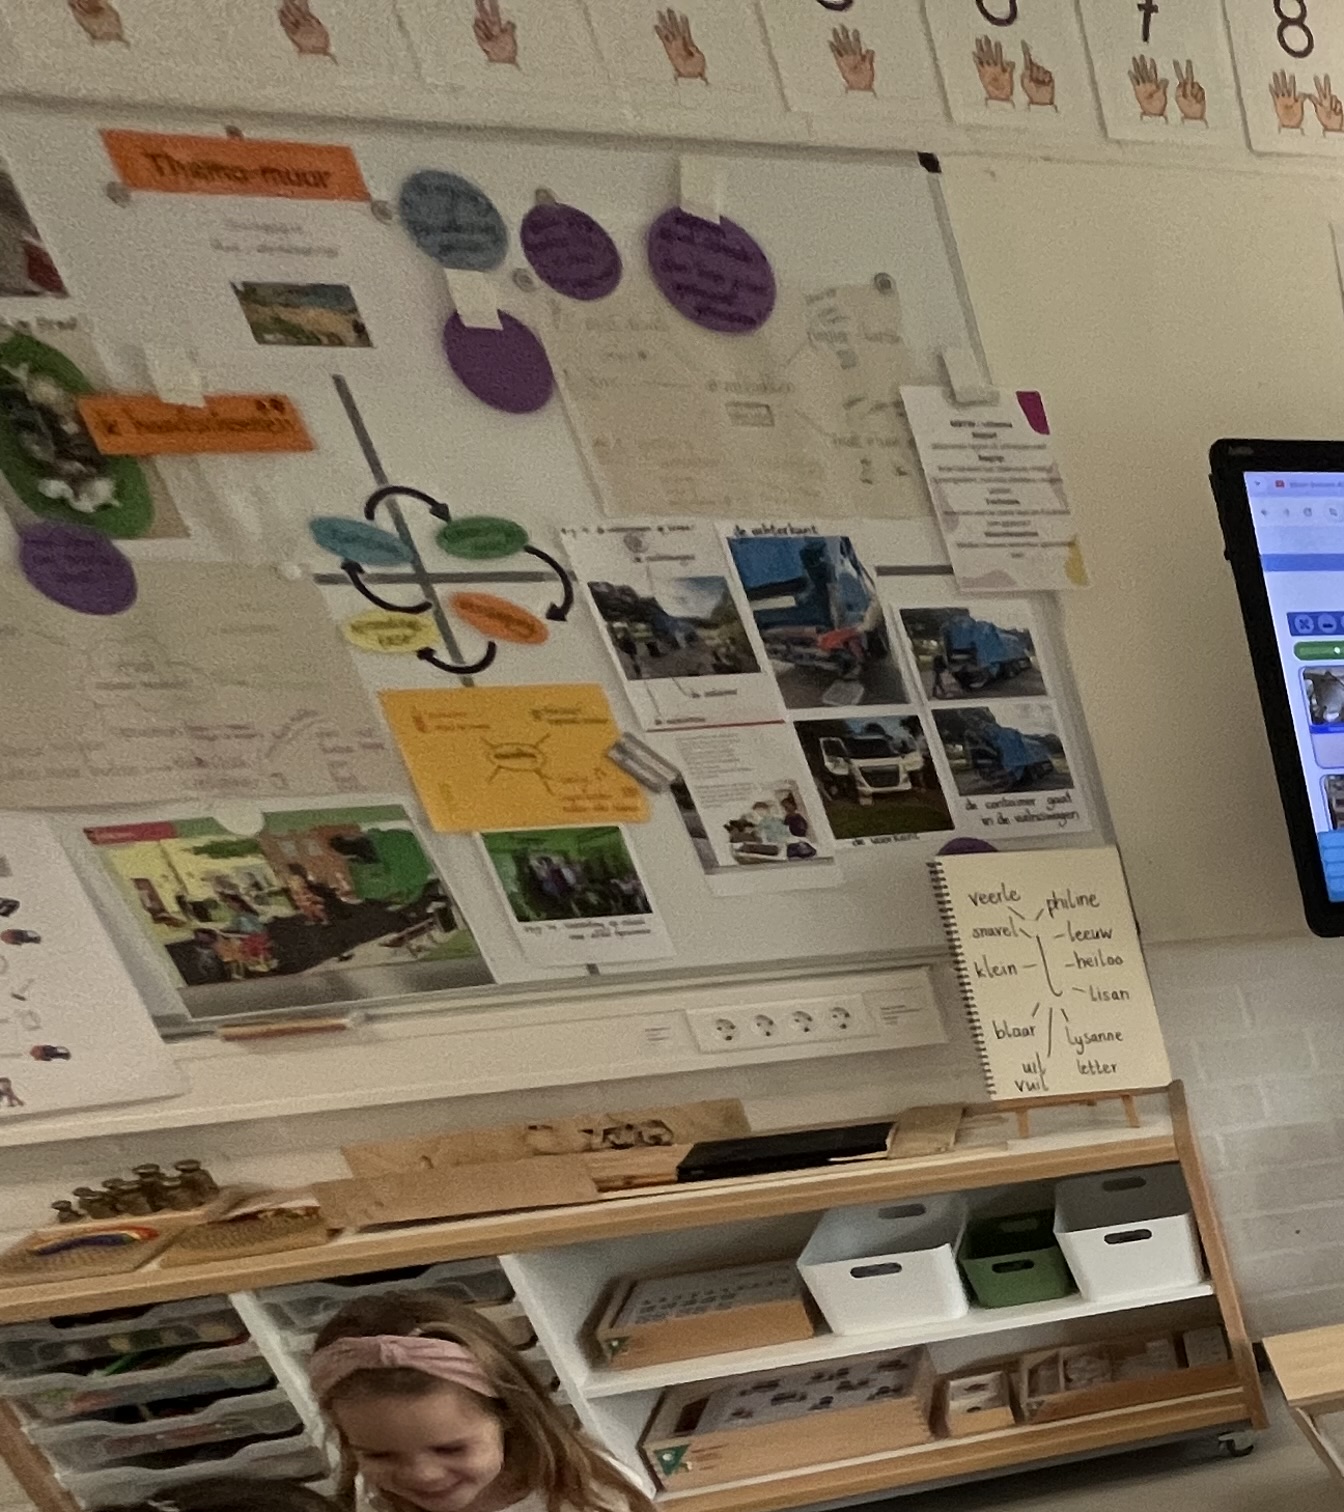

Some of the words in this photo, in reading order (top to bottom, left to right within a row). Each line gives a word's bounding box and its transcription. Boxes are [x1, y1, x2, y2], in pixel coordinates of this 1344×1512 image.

[1274, 0, 1314, 58] 8
[967, 882, 1021, 907] veerle
[1046, 887, 1101, 919] philine
[971, 915, 1019, 940] snavel
[1066, 919, 1113, 943] leeuw
[973, 953, 1018, 979] klein
[1073, 948, 1124, 970] heiloo
[992, 1019, 1037, 1040] blaar
[1022, 1051, 1047, 1076] uil
[1075, 1059, 1118, 1076] letter
[1014, 1075, 1049, 1093] vuil
